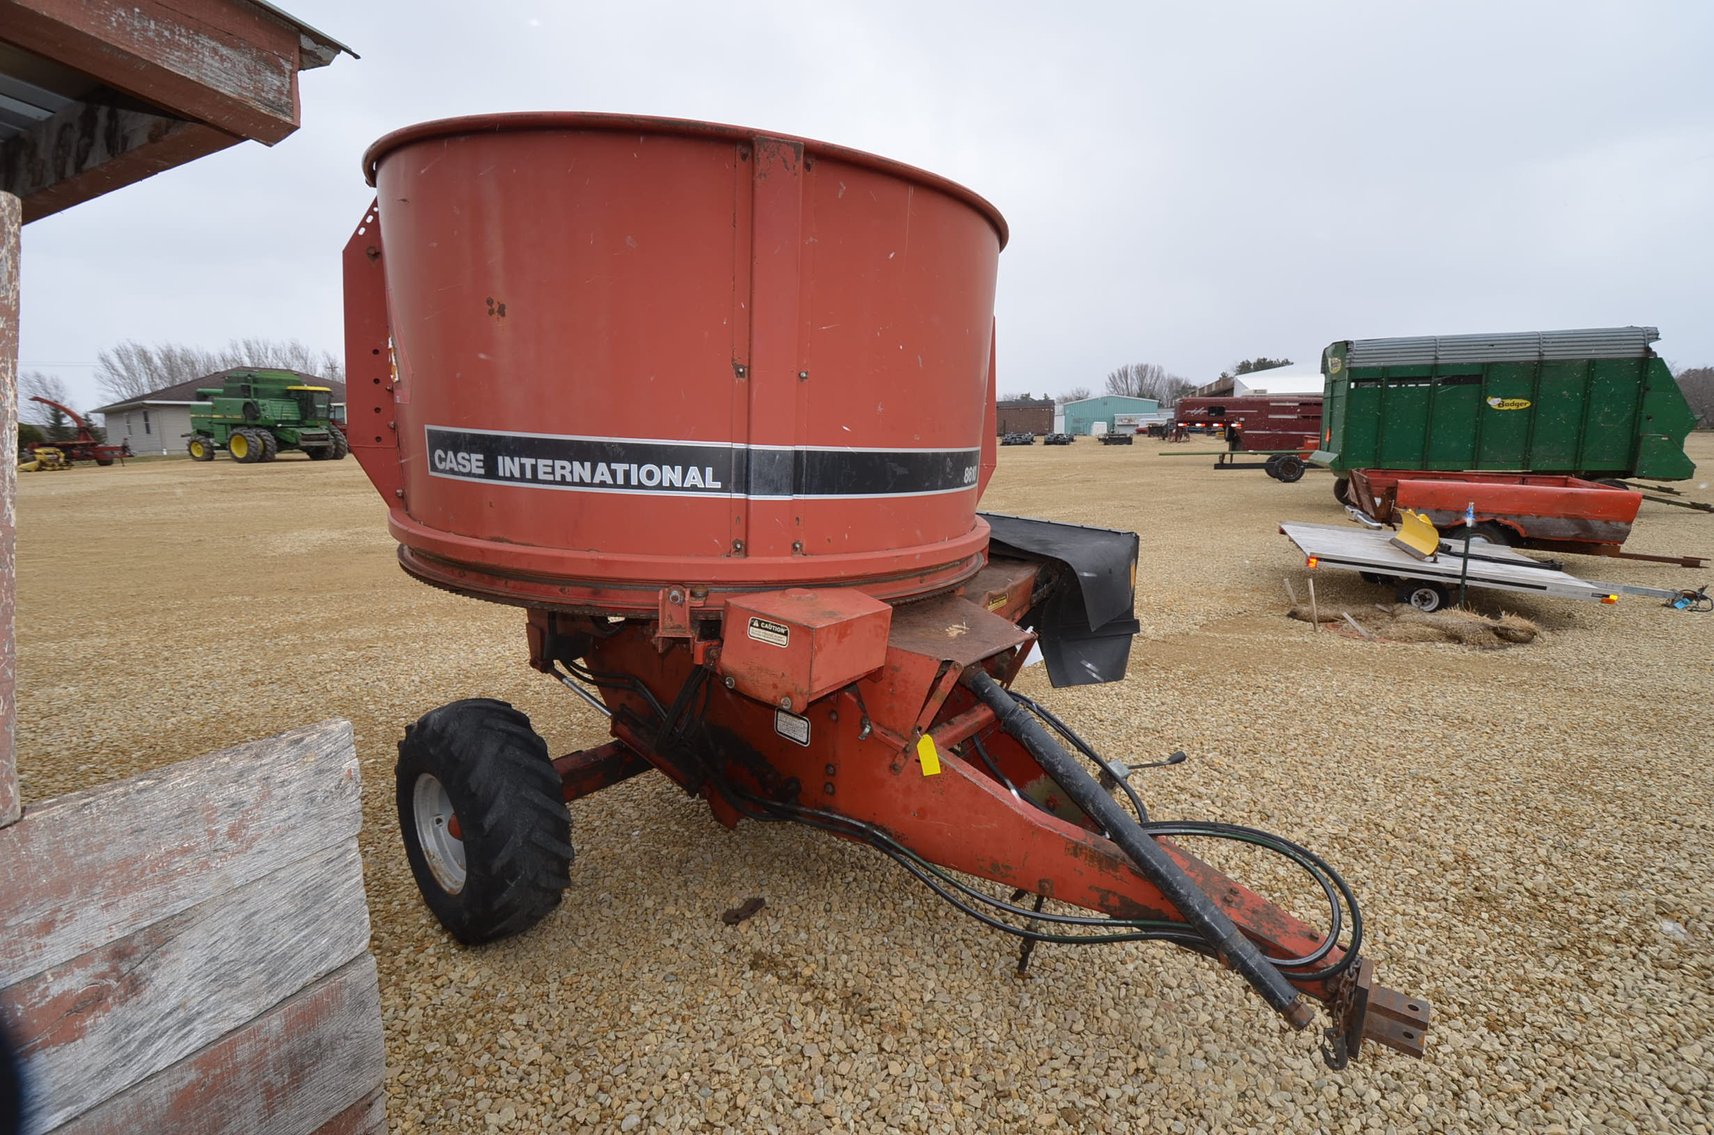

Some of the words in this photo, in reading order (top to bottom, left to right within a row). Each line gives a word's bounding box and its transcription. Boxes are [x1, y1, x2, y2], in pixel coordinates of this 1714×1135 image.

[434, 449, 485, 475] CASE
[497, 455, 722, 489] INTERNATIONAL
[760, 622, 785, 634] CAUTION
